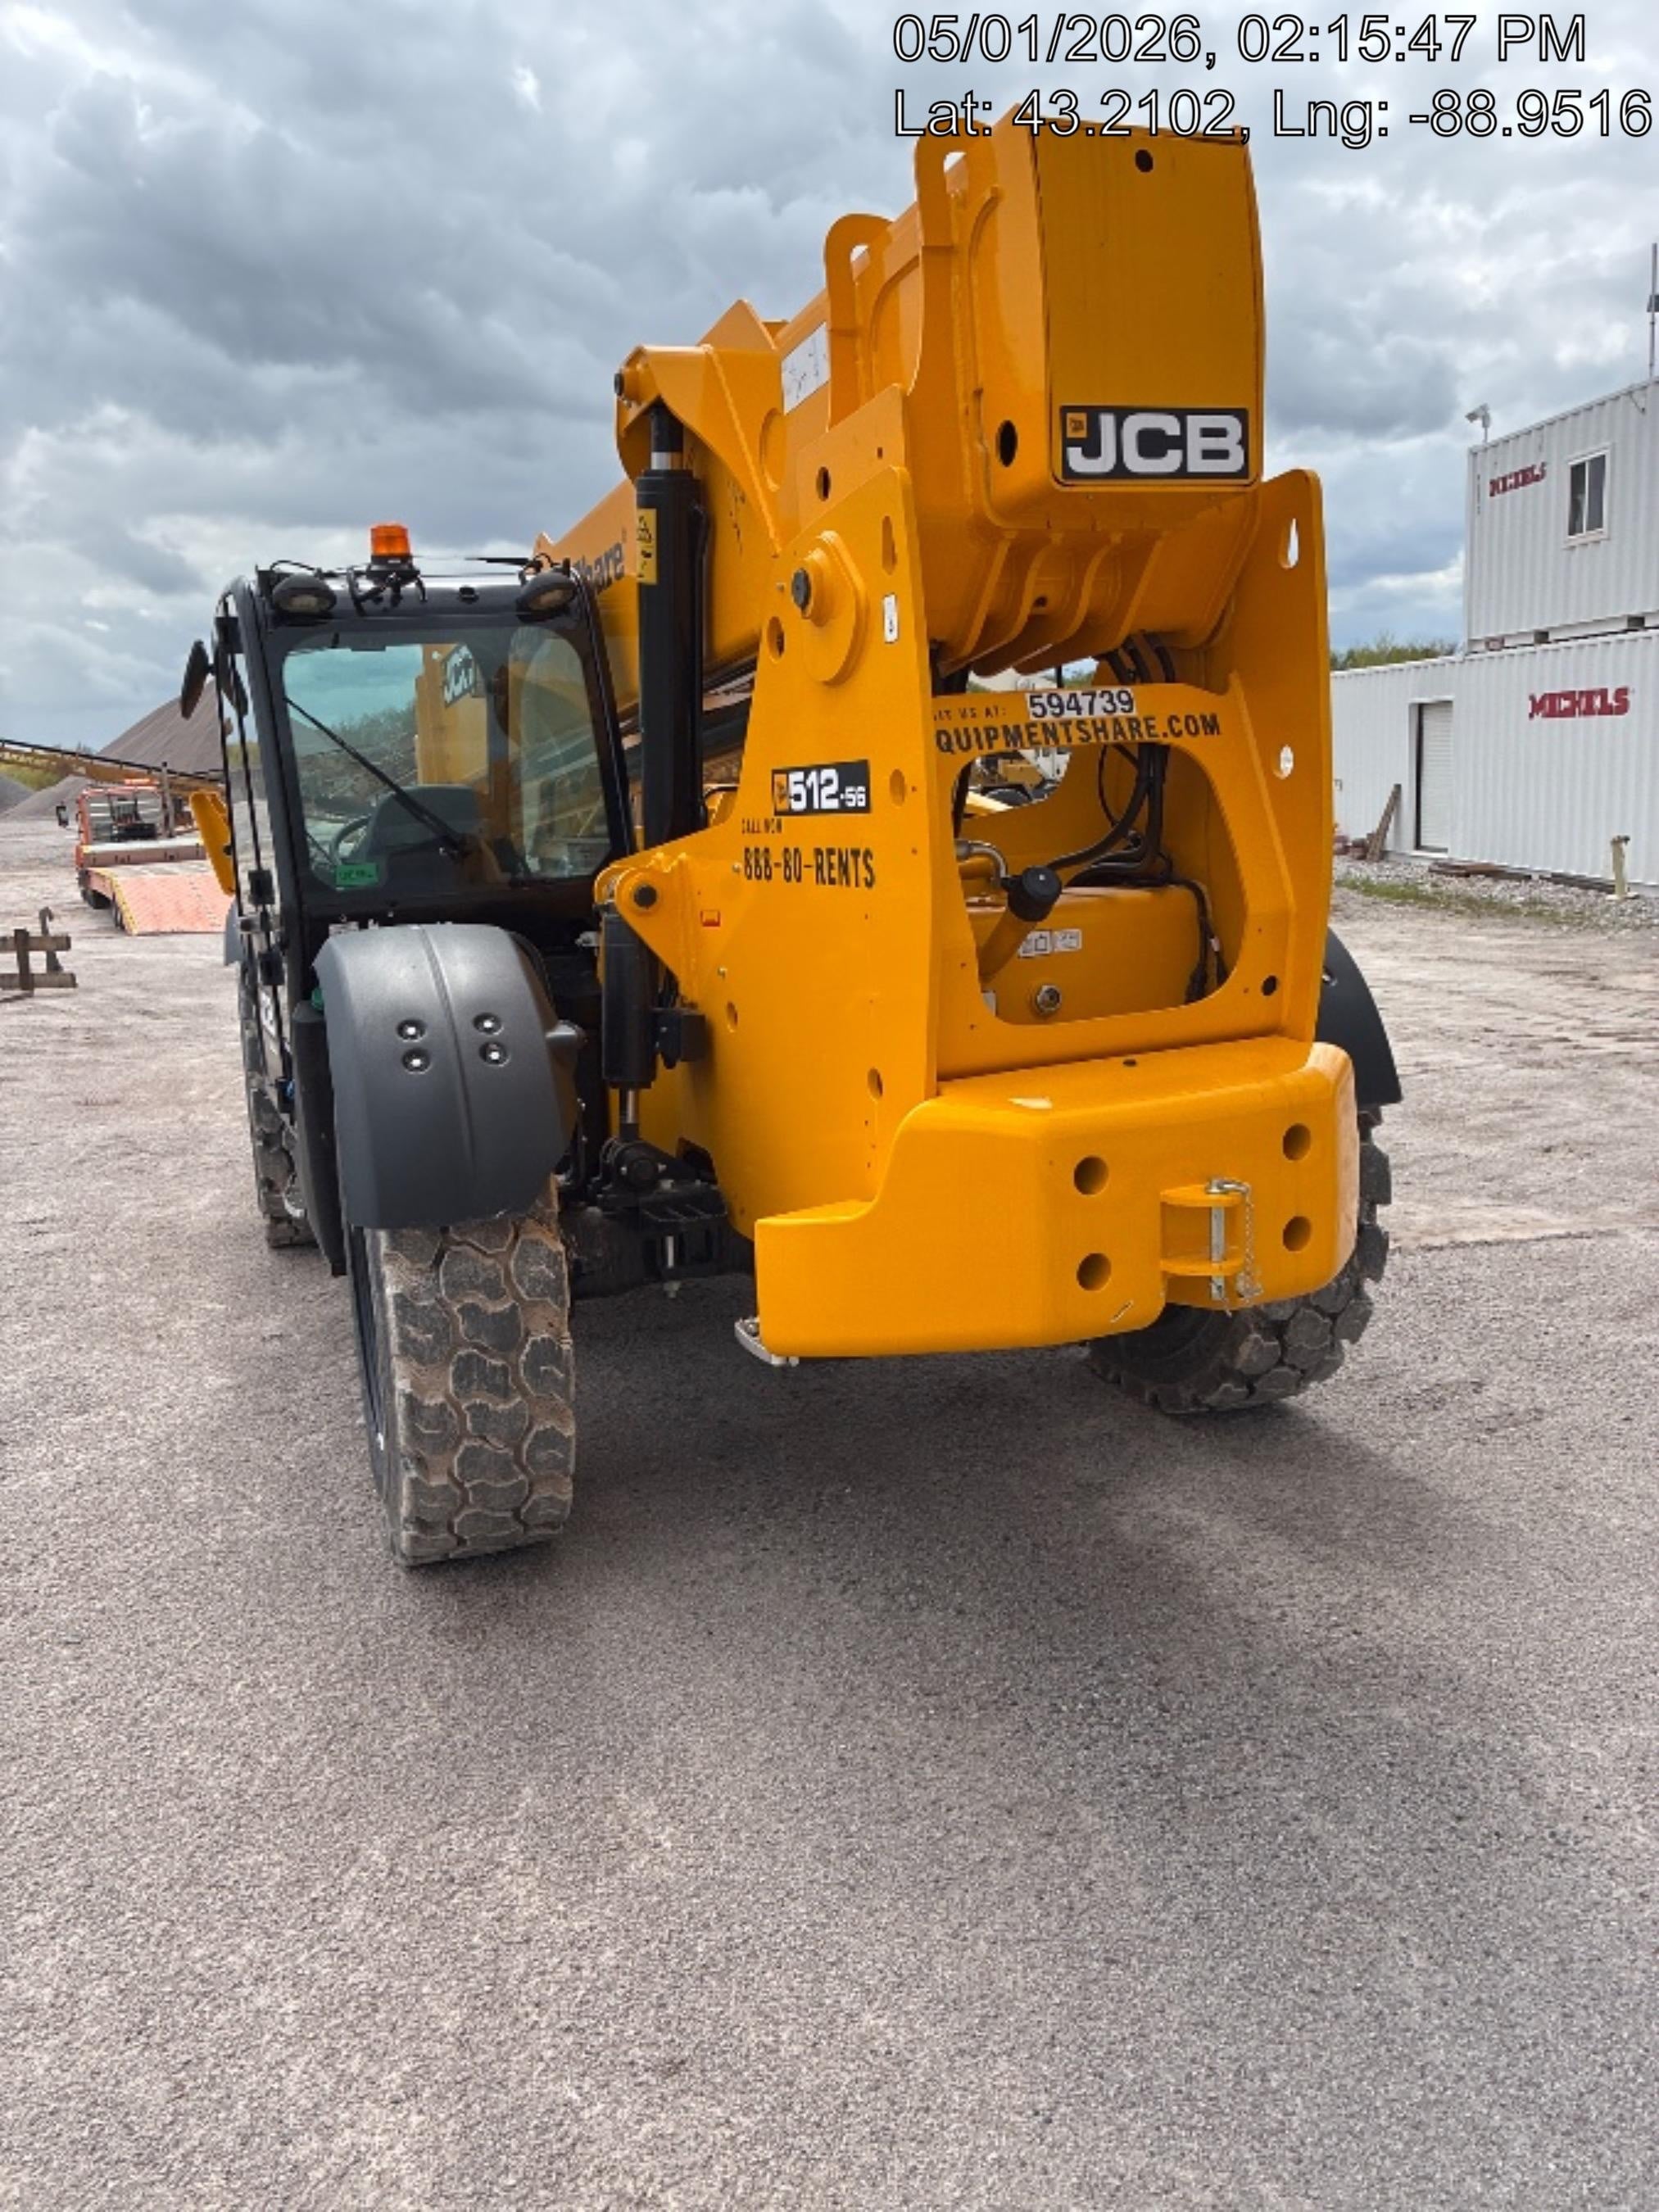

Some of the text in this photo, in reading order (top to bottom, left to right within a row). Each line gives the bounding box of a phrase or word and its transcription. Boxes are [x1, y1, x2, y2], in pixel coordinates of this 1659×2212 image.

[1067, 413, 1245, 474] JCB
[1029, 689, 1135, 718] 594739
[1528, 687, 1630, 721] MICHELS
[935, 713, 1221, 755] QUIPMENTSHARE.COM
[788, 768, 866, 811] 512-56
[744, 846, 876, 888] 888-80-RENTS
